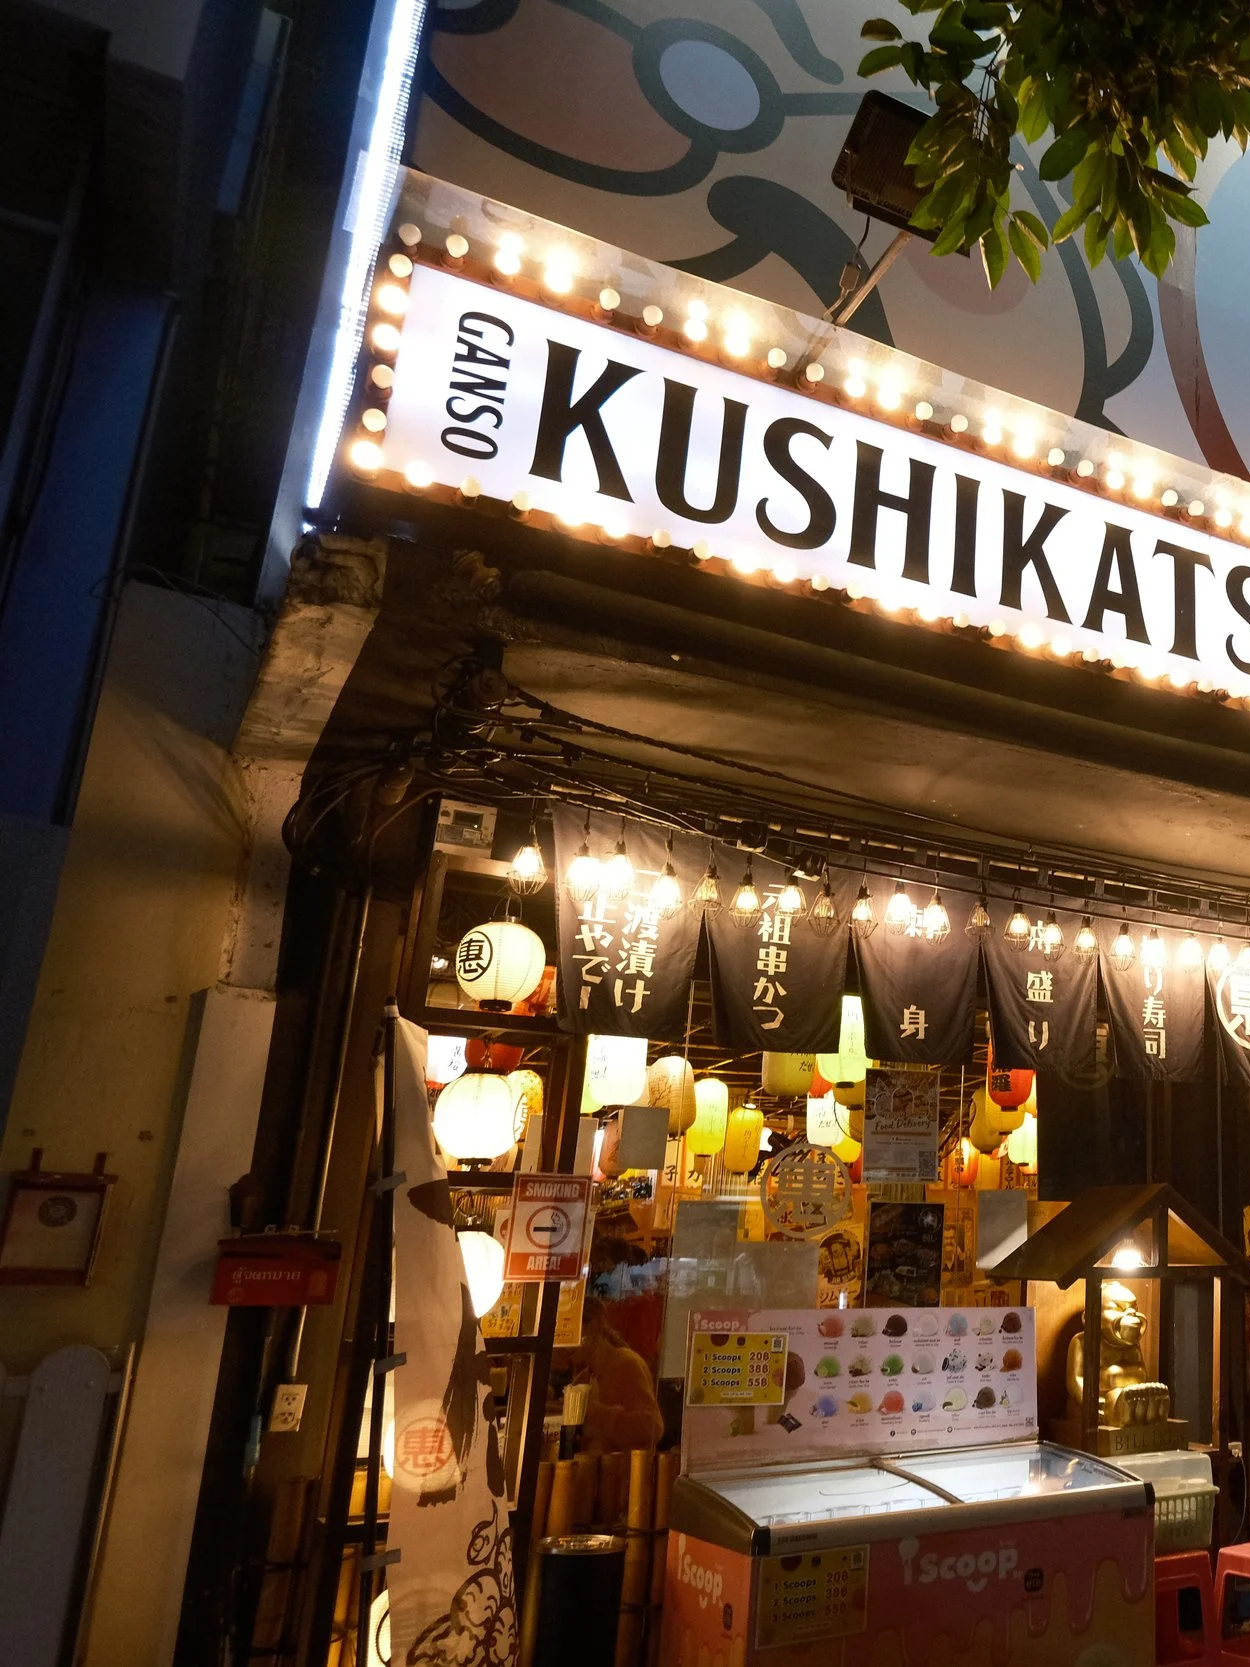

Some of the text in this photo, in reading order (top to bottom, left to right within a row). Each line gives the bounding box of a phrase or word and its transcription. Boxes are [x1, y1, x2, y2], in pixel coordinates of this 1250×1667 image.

[440, 310, 515, 461] GANSO
[525, 1181, 581, 1199] SMOKING
[526, 1255, 562, 1272] AREA!
[712, 1353, 742, 1362] Scoops
[711, 1366, 741, 1375] Scoops
[710, 1378, 740, 1387] Scoops
[783, 1578, 817, 1589] Scoops
[782, 1594, 817, 1605] Scoops
